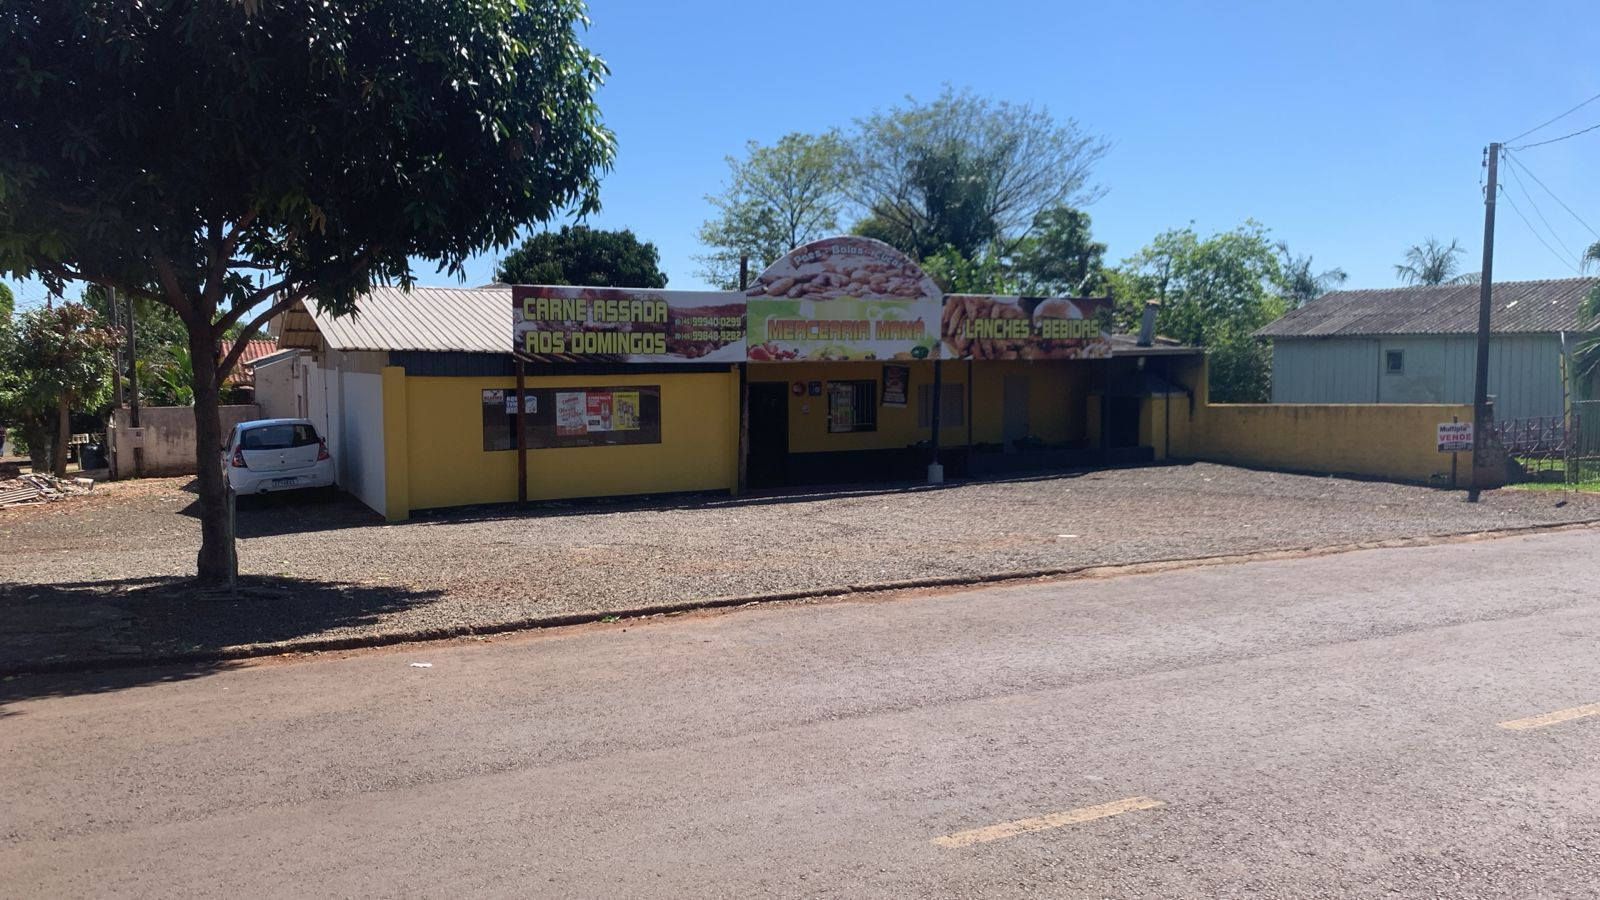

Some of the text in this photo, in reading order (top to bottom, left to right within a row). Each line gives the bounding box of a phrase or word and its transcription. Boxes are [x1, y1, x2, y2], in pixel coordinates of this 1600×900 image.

[523, 297, 668, 323] CARNE ASSADA
[768, 316, 925, 341] MERCEARIA MANÁ
[965, 318, 1100, 339] LANCHES BEBIDAS
[525, 330, 667, 356] AOS DOMINGOS
[1440, 433, 1472, 442] VENDE
